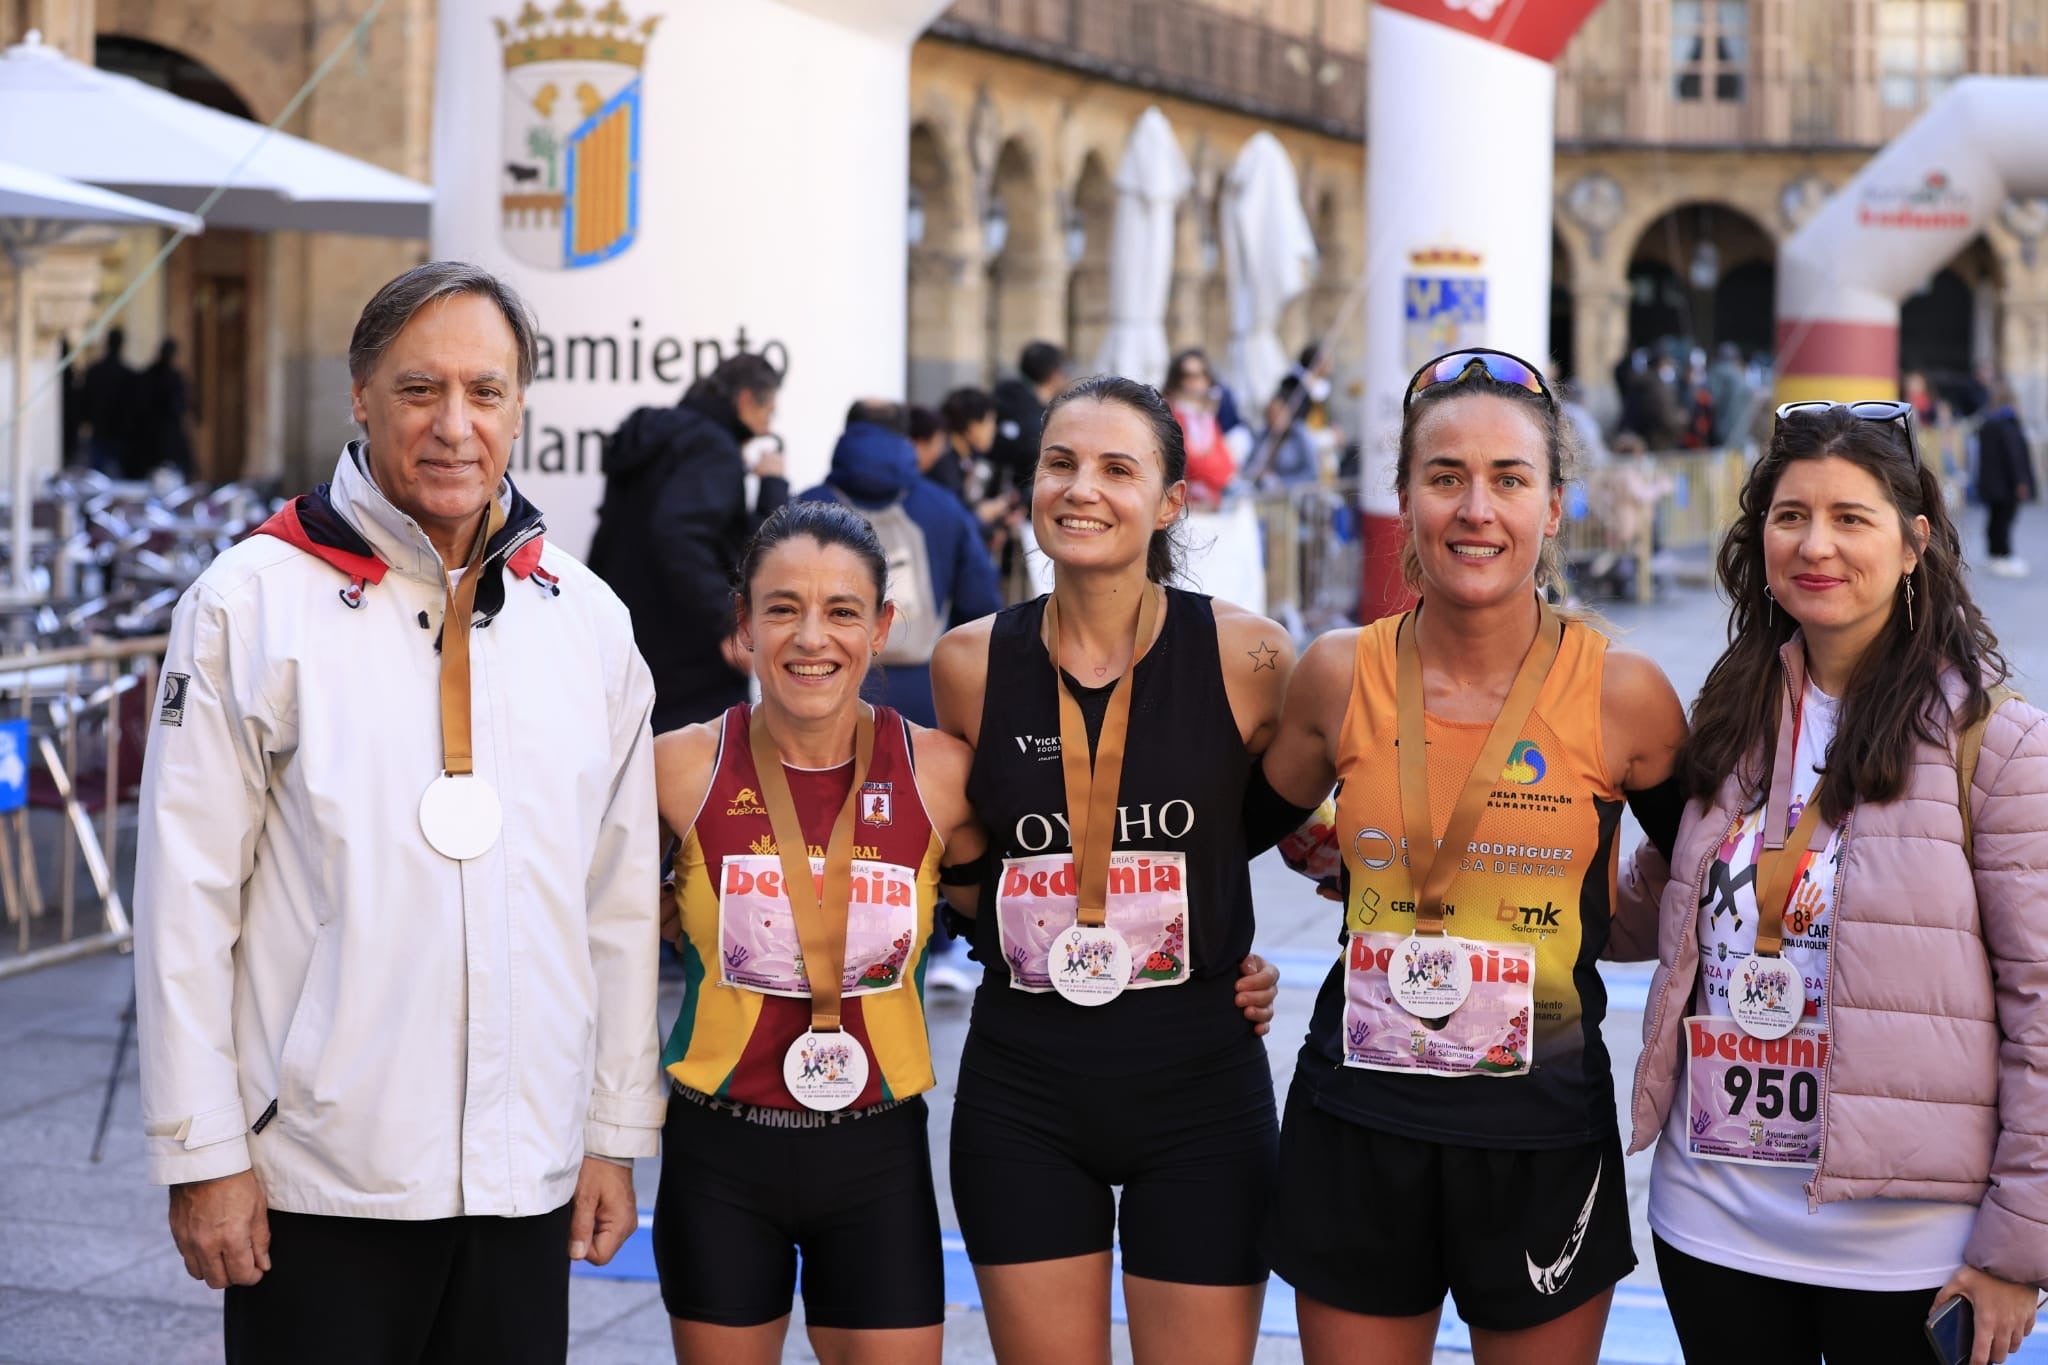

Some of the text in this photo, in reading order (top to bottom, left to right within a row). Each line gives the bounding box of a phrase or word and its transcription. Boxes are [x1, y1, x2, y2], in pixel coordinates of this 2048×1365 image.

[1037, 745, 1061, 753] FOODS
[1016, 800, 1195, 851] OYHO
[1467, 841, 1573, 860] RODRÍGUEZ
[1494, 861, 1566, 877] DENTAL
[726, 864, 911, 908] benia
[1002, 859, 1181, 897] bednia
[1429, 1040, 1474, 1052] Ayuntamiento
[1438, 1051, 1474, 1060] Salamanca
[1724, 1065, 1818, 1123] 950
[746, 1106, 826, 1129] ARMOUR
[1766, 1130, 1808, 1140] Ayuntamiento
[1765, 1139, 1809, 1149] de Salamanca
